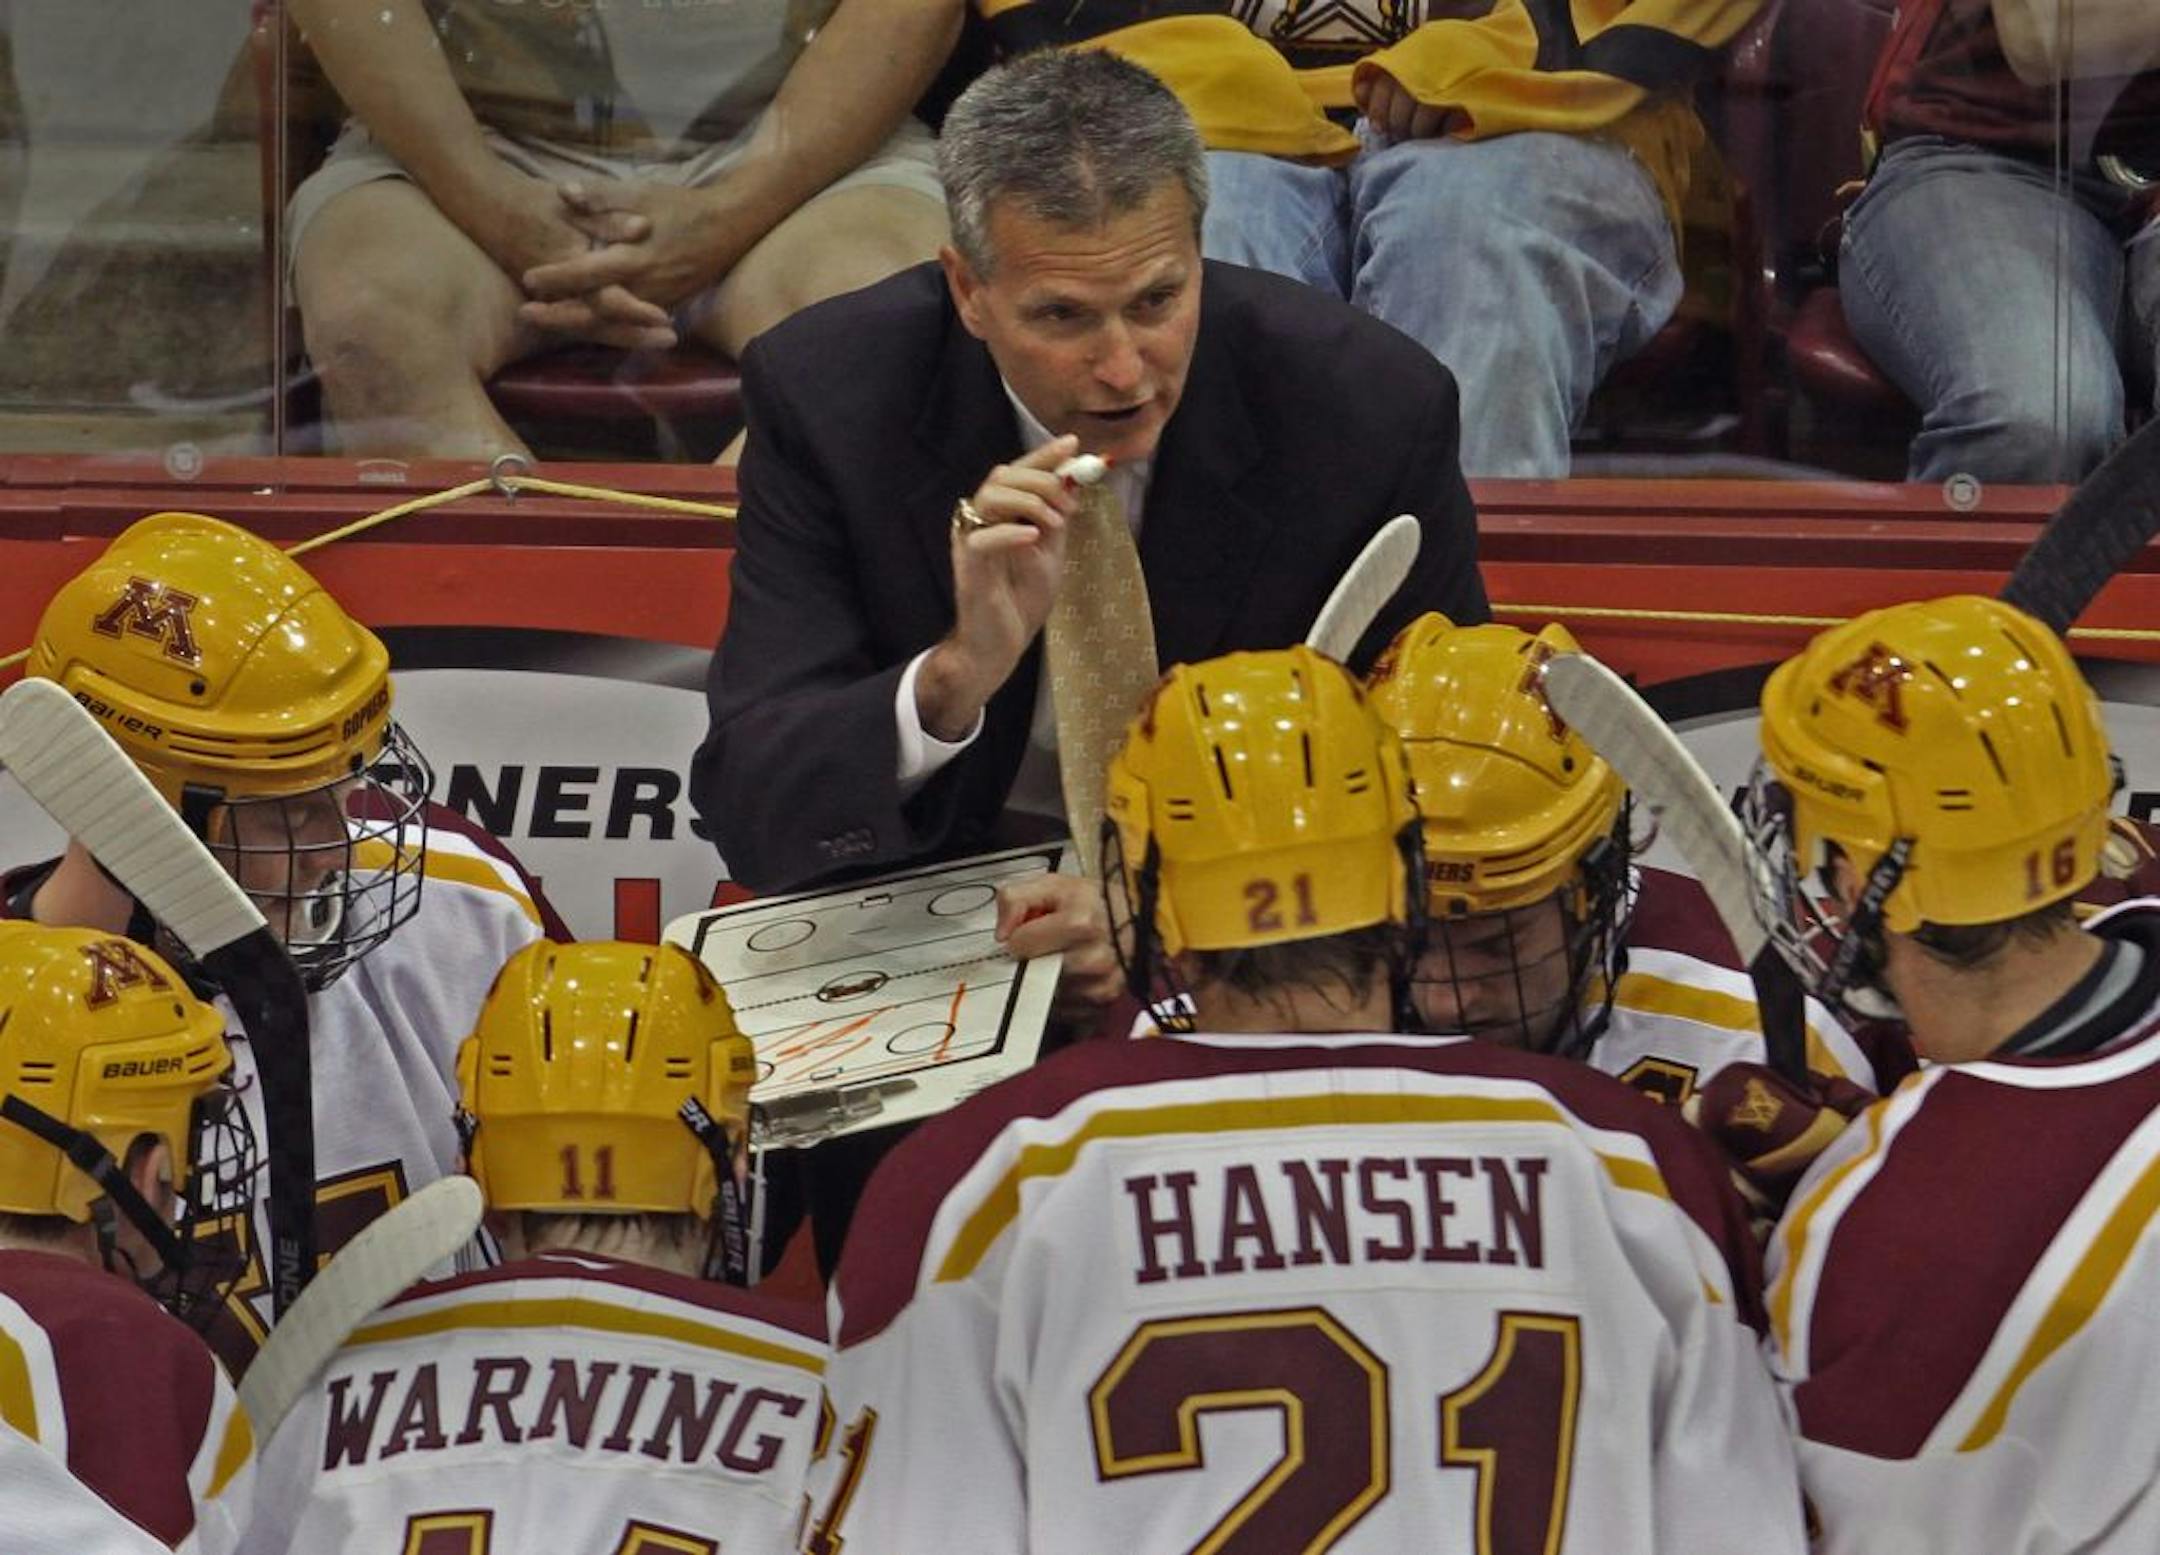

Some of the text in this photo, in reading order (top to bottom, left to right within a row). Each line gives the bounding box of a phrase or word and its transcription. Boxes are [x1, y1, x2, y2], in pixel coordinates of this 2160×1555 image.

[92, 576, 202, 668] M
[1242, 872, 1318, 933] 21
[2024, 836, 2077, 901] 16
[558, 1143, 617, 1199] 11
[1125, 1156, 1549, 1284] HANSEN
[323, 1356, 807, 1474] WARNING
[1087, 1305, 1582, 1555] 21
